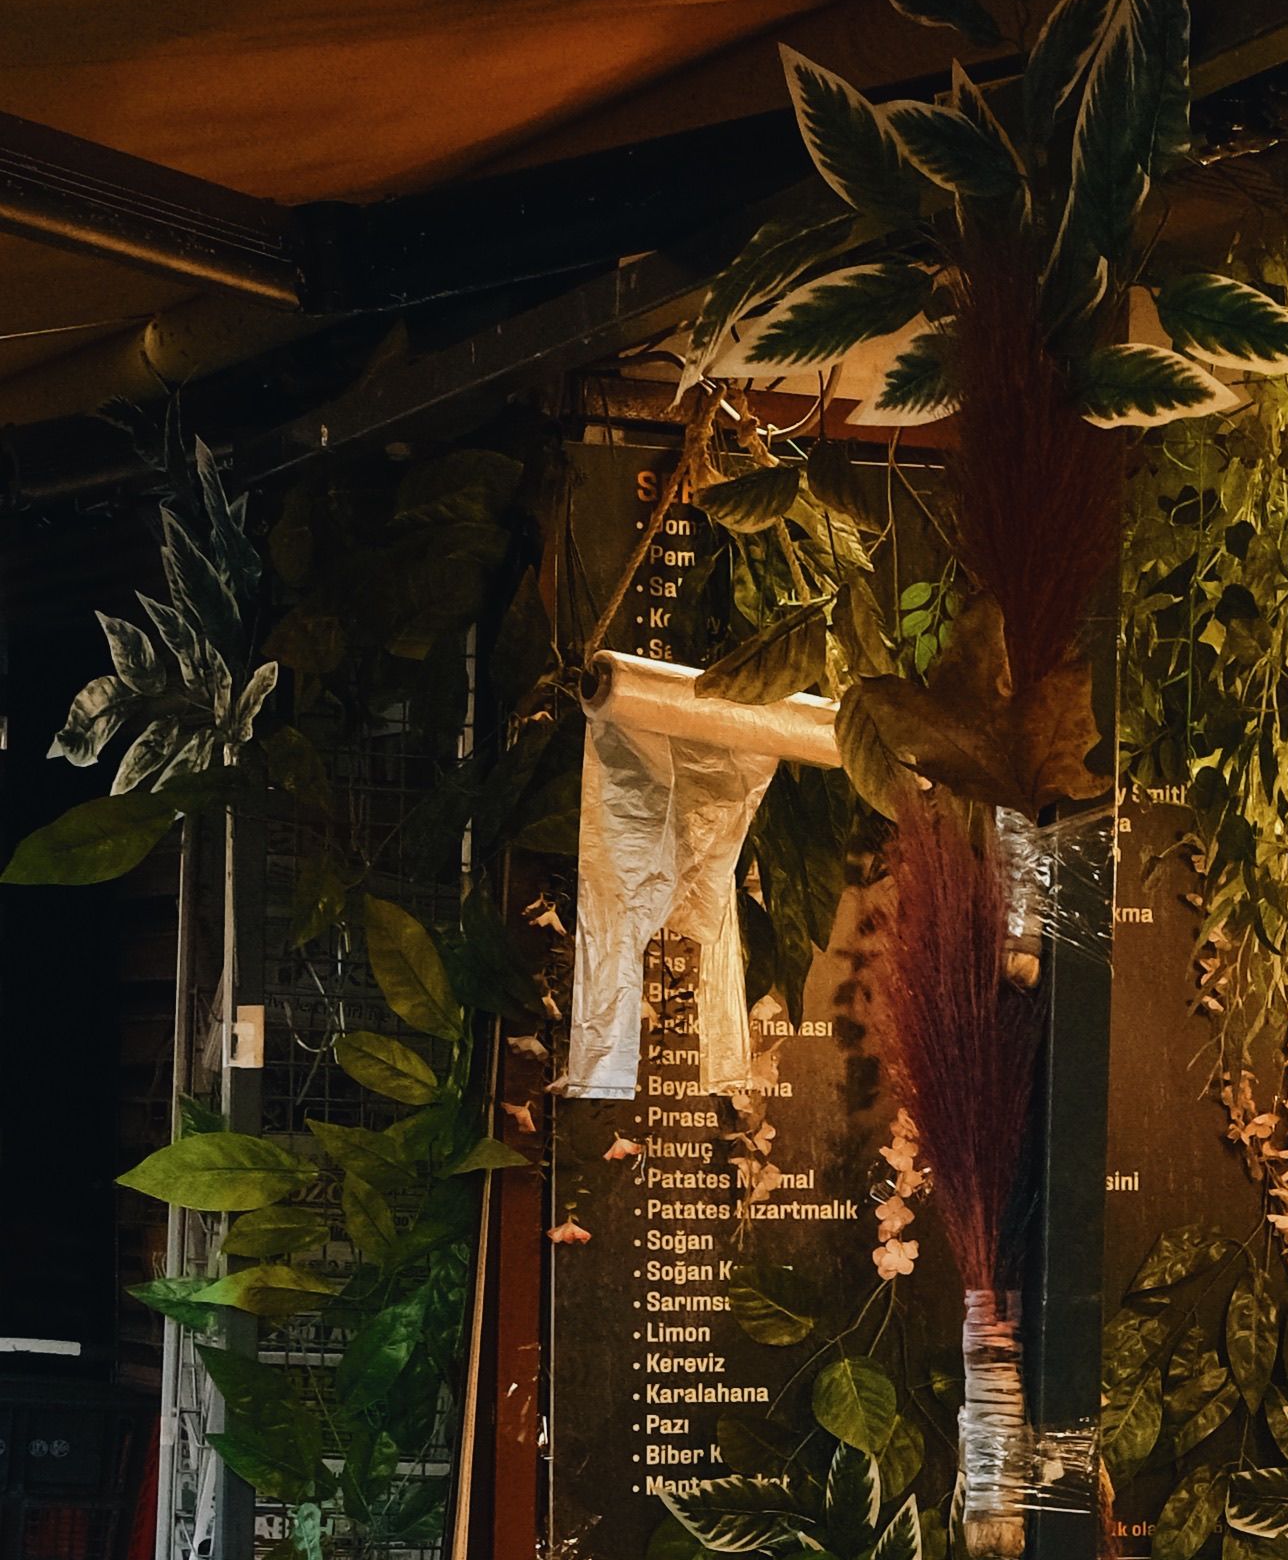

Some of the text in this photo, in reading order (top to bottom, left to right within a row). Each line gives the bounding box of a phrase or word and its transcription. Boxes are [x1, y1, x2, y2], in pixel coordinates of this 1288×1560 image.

[648, 1107, 719, 1127] Pırasa
[648, 1137, 713, 1164] Havuç
[647, 1169, 815, 1189] Patates Nmal
[647, 1200, 732, 1220] Patates
[647, 1230, 714, 1254] Soğan
[647, 1261, 713, 1285] Soğan
[647, 1322, 711, 1342] Limon
[646, 1353, 726, 1373] Kereviz
[646, 1383, 770, 1404] Karalahana
[646, 1414, 690, 1435] Pazı
[646, 1444, 705, 1465] Biber
